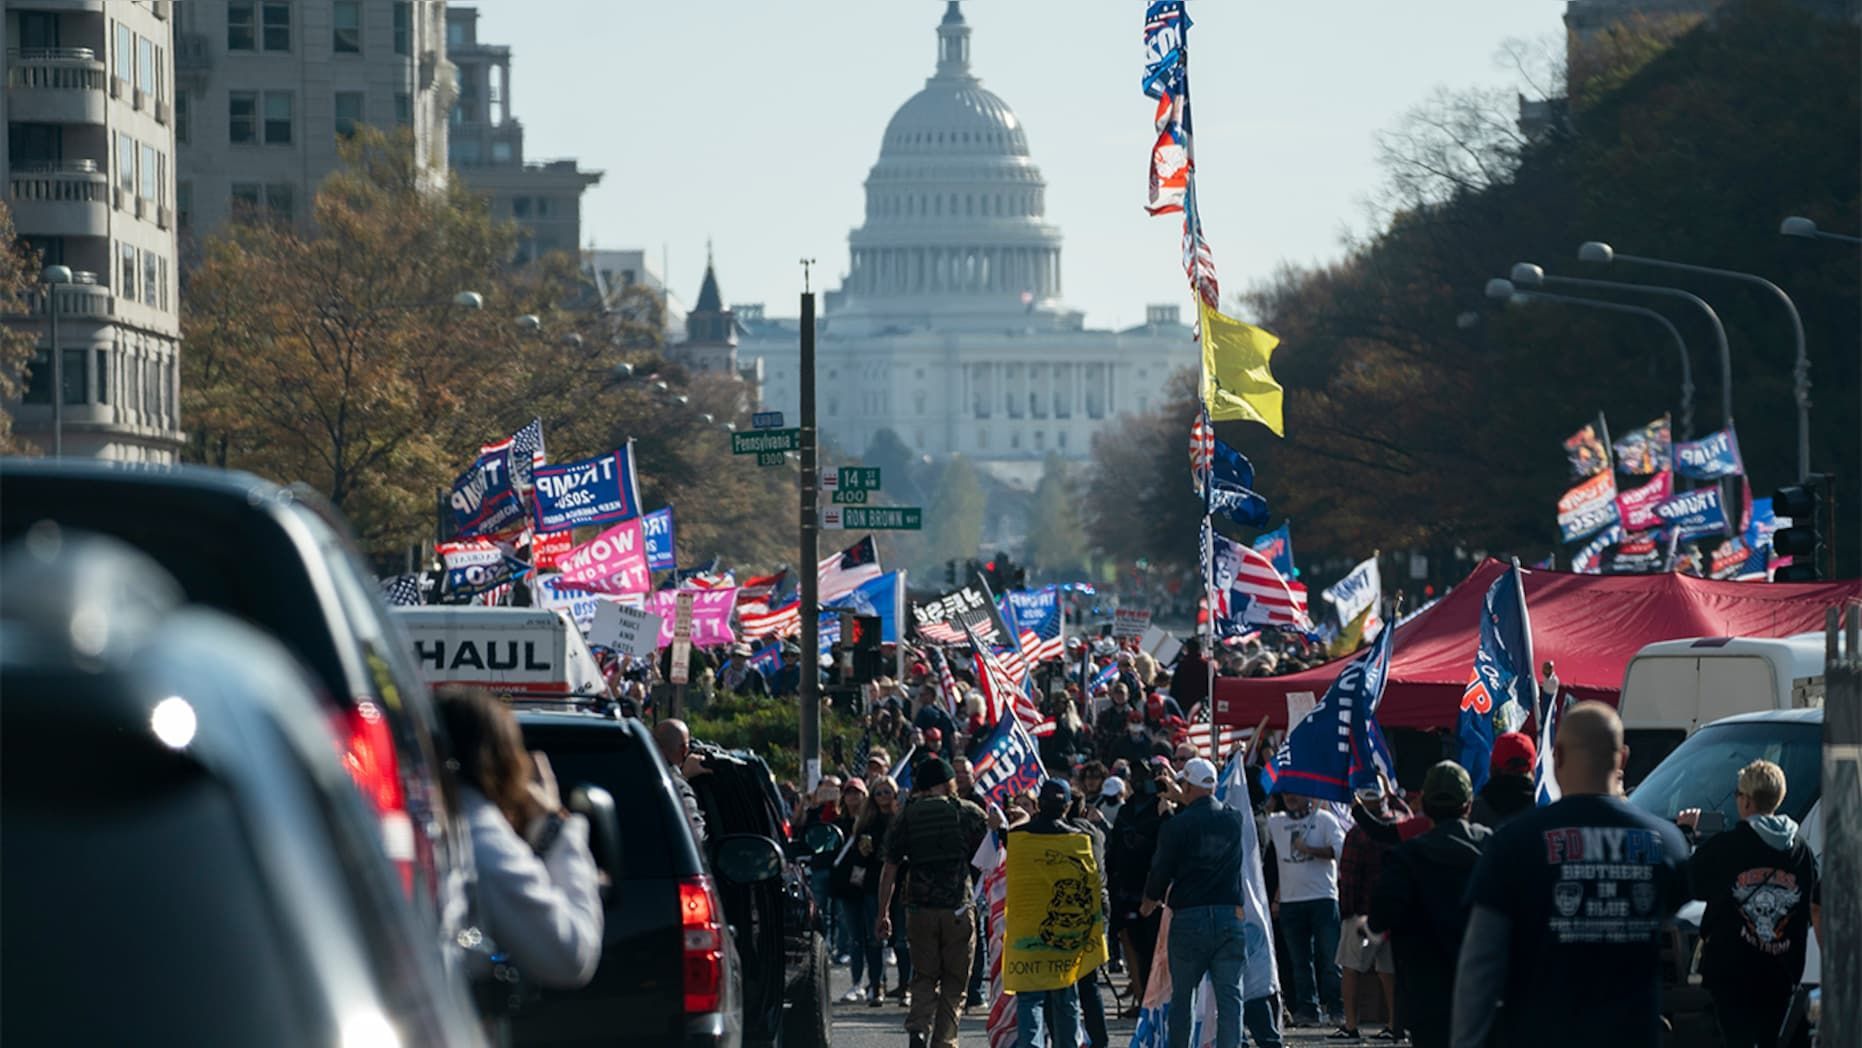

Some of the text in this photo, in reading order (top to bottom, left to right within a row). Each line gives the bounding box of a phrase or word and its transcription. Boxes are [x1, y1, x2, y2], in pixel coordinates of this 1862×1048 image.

[735, 433, 790, 451] Pennsylvania
[761, 454, 783, 465] 1300
[844, 470, 858, 487] 14
[836, 491, 864, 501] 400
[846, 510, 866, 526] RON
[869, 510, 904, 526] BROWN
[619, 605, 646, 619] ARREST
[619, 631, 635, 641] AND
[414, 640, 551, 670] HAUL
[1544, 826, 1662, 864] FDNYPD
[1561, 865, 1653, 879] BROTHERS
[1598, 882, 1617, 898] IN
[1586, 901, 1630, 917] BLUE
[1008, 960, 1041, 975] DONT
[1049, 959, 1078, 975] TRE
